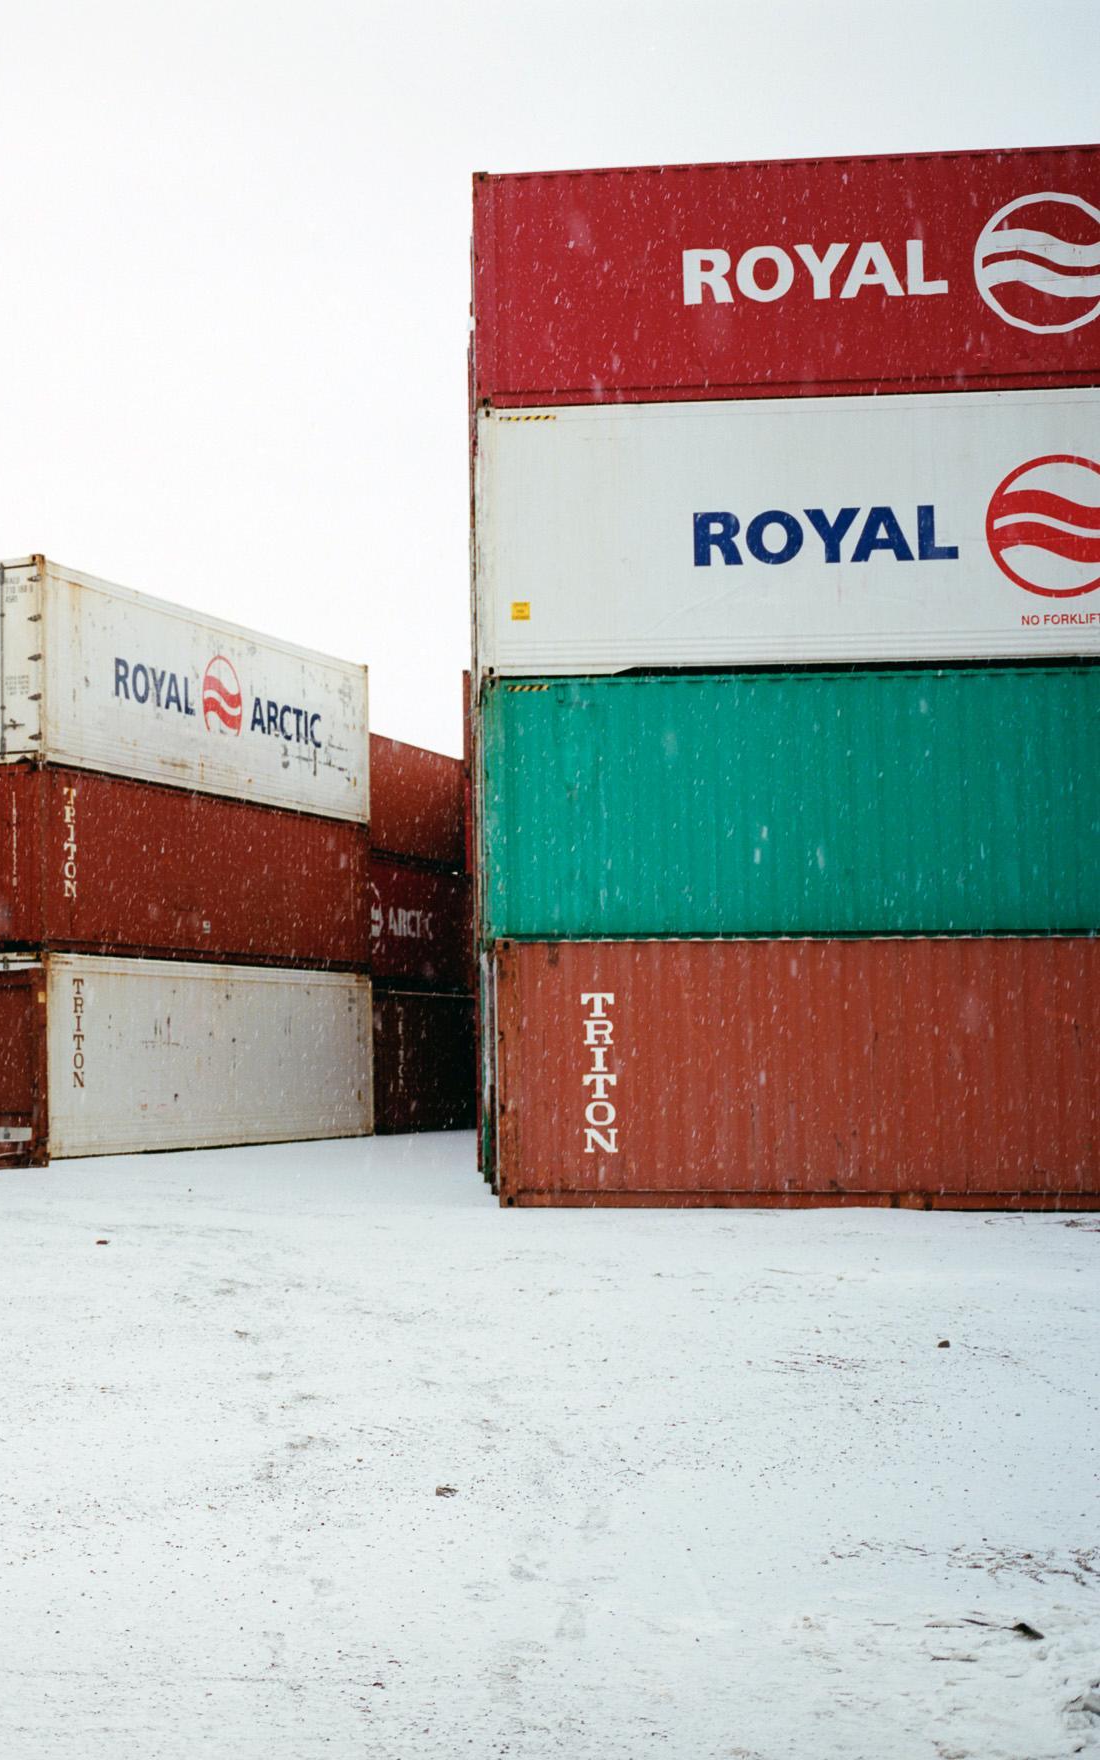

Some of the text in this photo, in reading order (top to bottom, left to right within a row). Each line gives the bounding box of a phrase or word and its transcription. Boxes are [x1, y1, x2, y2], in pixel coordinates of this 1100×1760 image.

[683, 240, 948, 305] ROYAL
[693, 505, 959, 566] ROYAL
[1021, 614, 1040, 625] NO
[115, 657, 322, 749] ROYAL ARCTIC
[63, 787, 77, 898] TRITON
[72, 978, 85, 1088] TRITON
[581, 993, 618, 1153] TRITON
